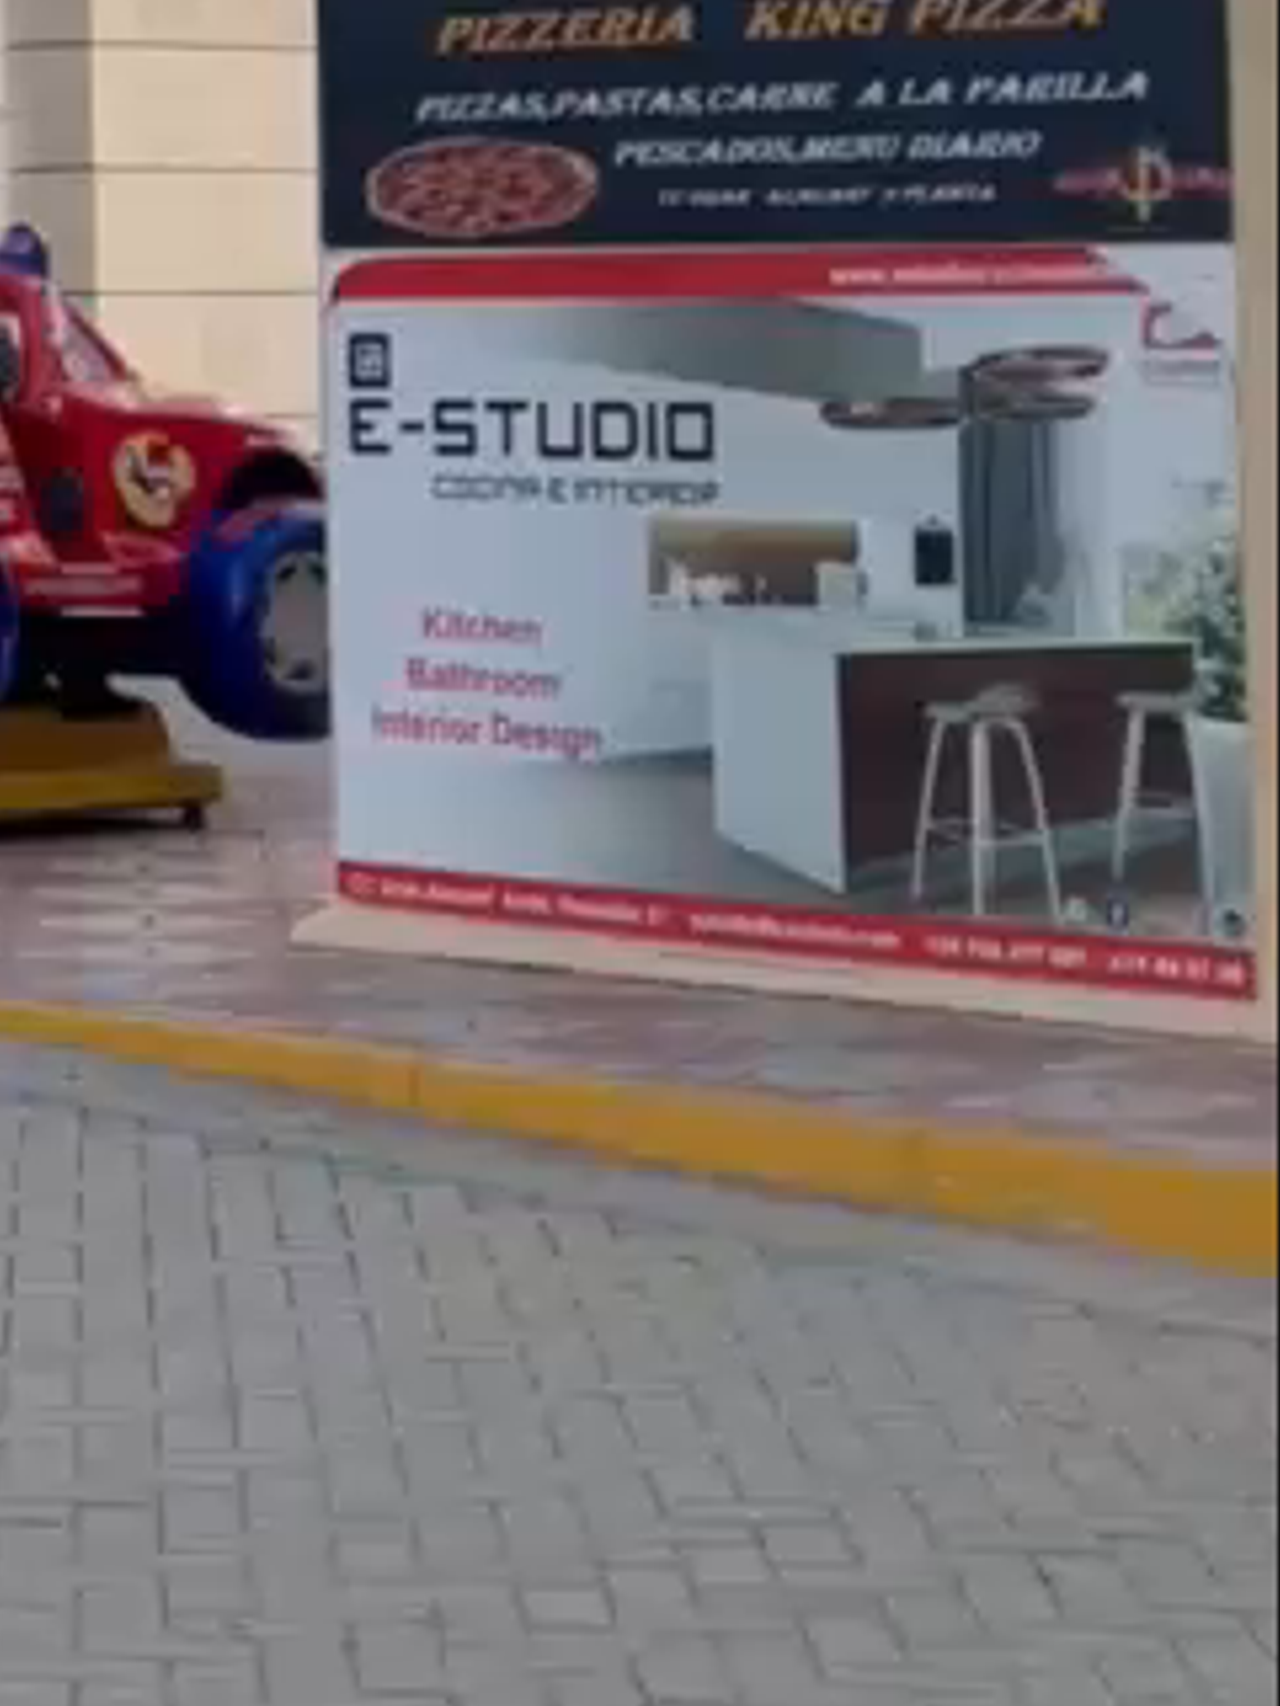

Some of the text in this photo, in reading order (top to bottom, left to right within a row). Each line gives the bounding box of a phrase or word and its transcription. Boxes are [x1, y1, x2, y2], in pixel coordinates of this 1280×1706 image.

[436, 3, 697, 54] PIZZERIA
[856, 80, 886, 107] A
[898, 77, 951, 106] LA
[908, 129, 1043, 163] DIARIO
[348, 397, 715, 463] E-STUDIO
[422, 606, 543, 644] Kitchen
[405, 657, 561, 700] Bathroom
[371, 704, 604, 765] Interior Design
